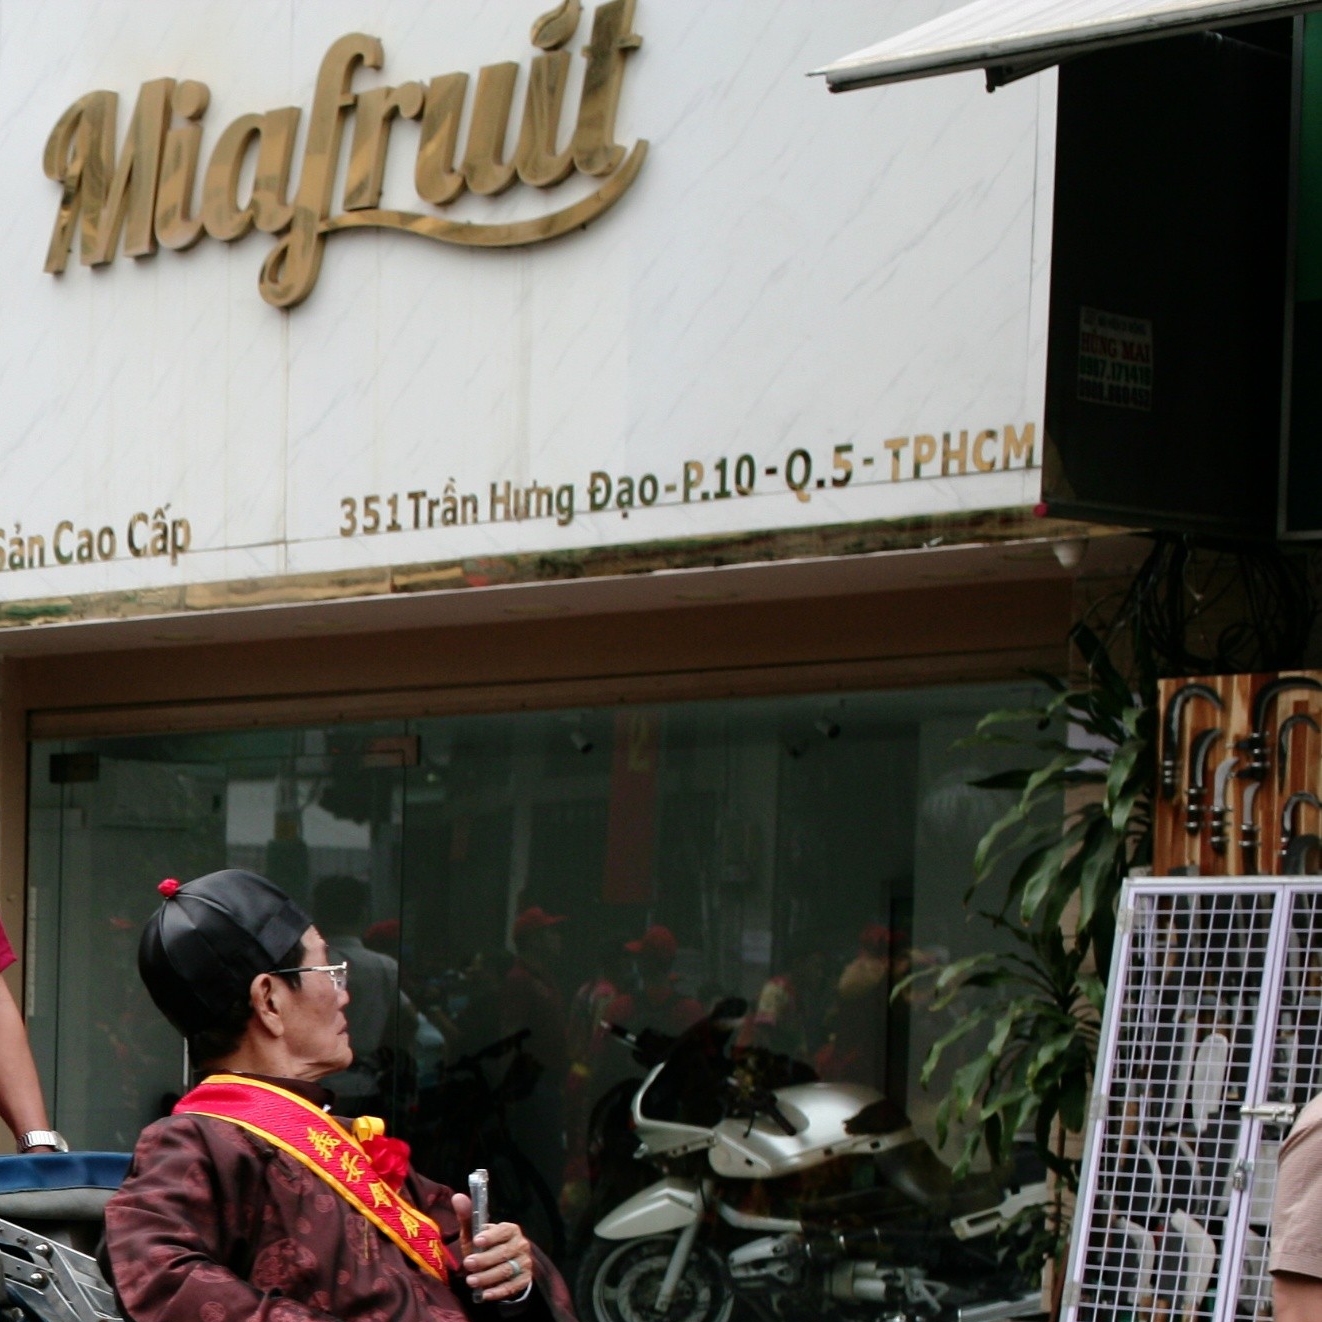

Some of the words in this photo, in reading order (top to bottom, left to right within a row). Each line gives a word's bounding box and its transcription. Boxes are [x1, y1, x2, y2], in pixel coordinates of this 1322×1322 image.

[43, 0, 643, 308] Miafruit
[53, 519, 117, 566] Cao
[126, 502, 192, 567] Cấp
[339, 495, 403, 538] 351
[407, 477, 478, 531] Trần
[489, 478, 575, 527] Hưng
[586, 469, 658, 519] Đạo
[884, 421, 1037, 483] TPHCM
